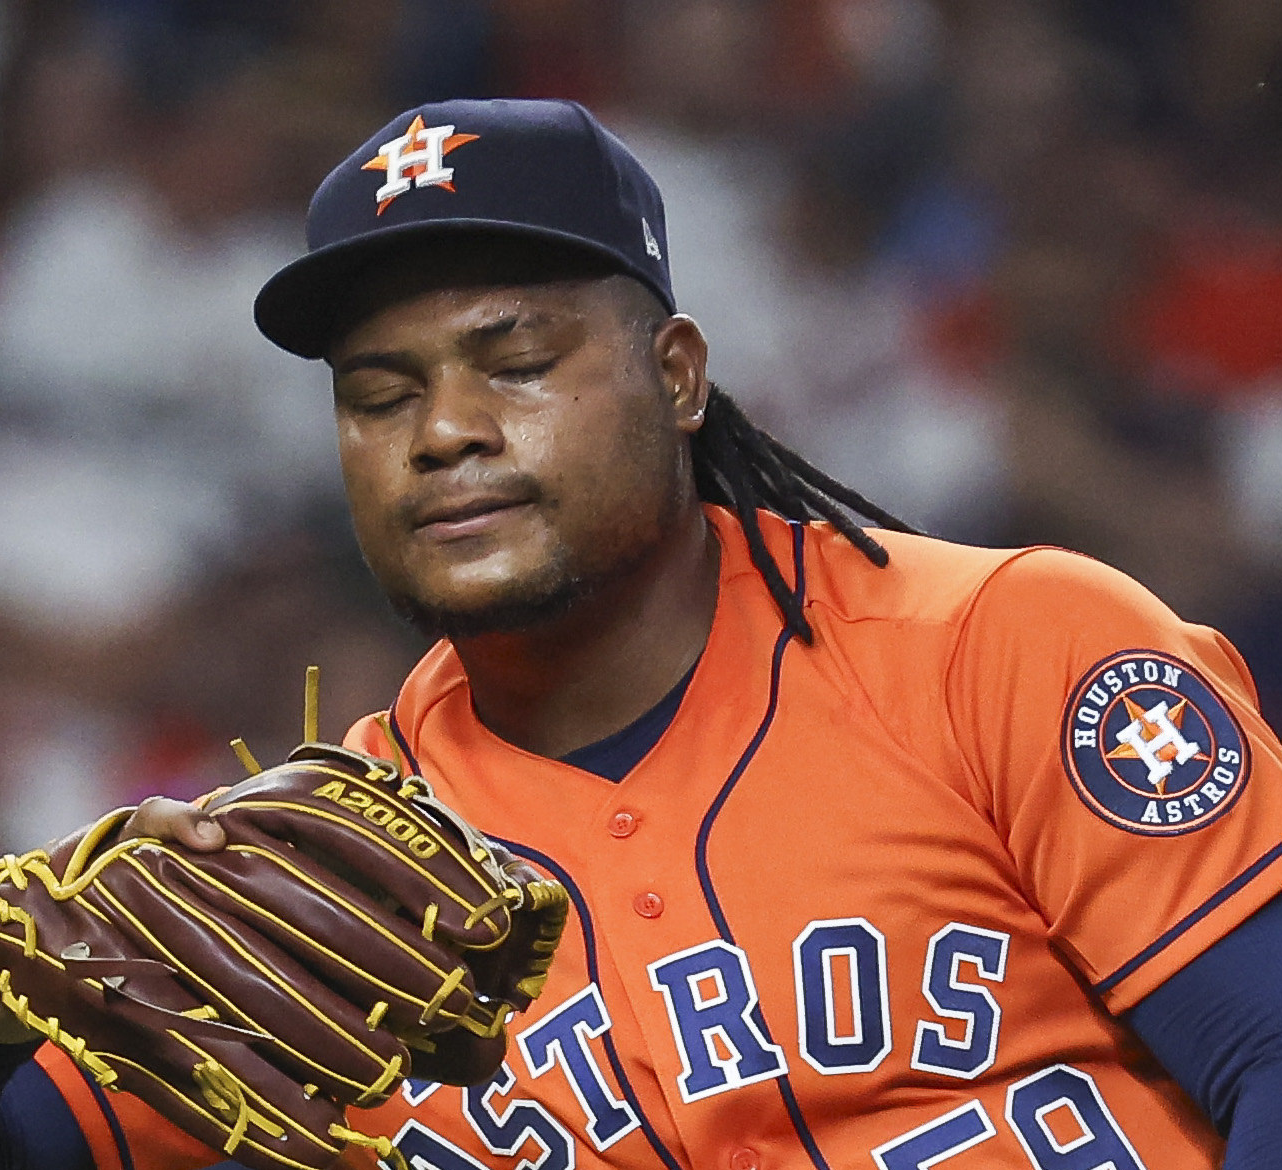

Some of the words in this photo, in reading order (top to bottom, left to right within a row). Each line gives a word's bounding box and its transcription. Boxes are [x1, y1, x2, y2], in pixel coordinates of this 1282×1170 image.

[376, 125, 456, 203] H
[1074, 660, 1182, 749] HOUSTON
[1116, 700, 1201, 785] H
[312, 780, 440, 859] A2000
[1140, 747, 1240, 824] ASTROS
